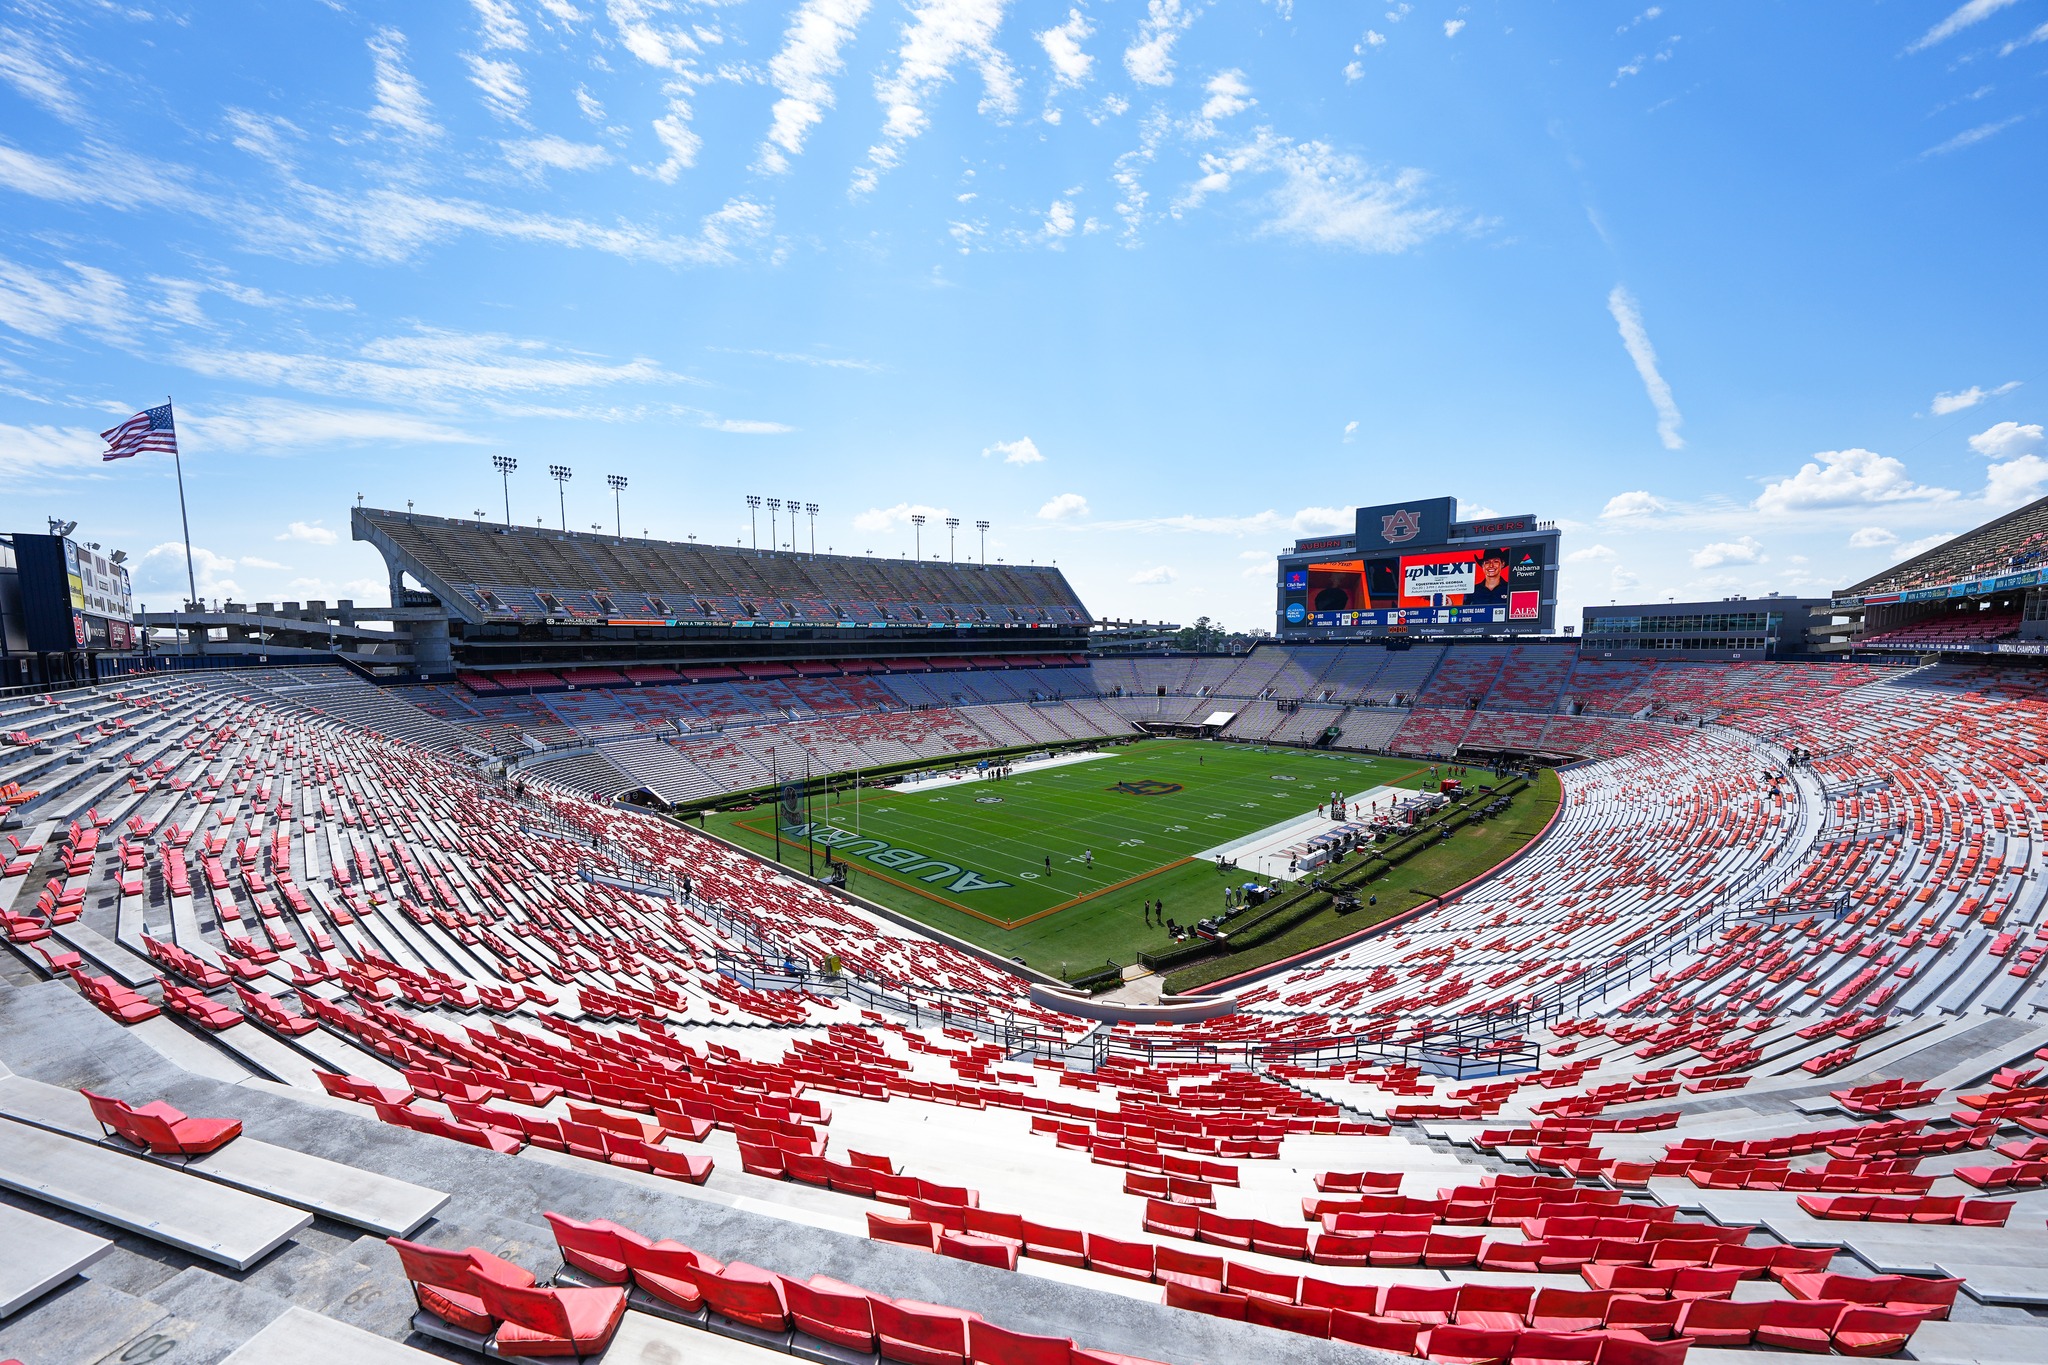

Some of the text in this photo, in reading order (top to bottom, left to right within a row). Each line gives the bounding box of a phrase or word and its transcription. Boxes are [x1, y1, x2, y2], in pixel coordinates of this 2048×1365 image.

[1381, 509, 1421, 542] AU
[1473, 521, 1525, 534] TIGERS
[1300, 540, 1341, 551] AUBURN
[1405, 562, 1476, 581] upNEXT
[2008, 578, 2016, 586] TRIP
[1998, 644, 2016, 653] NATIONAL
[2016, 645, 2041, 654] CHAMPIONS
[1121, 838, 1145, 848] 20
[779, 821, 1016, 894] AUBURN
[1019, 871, 1041, 880] G
